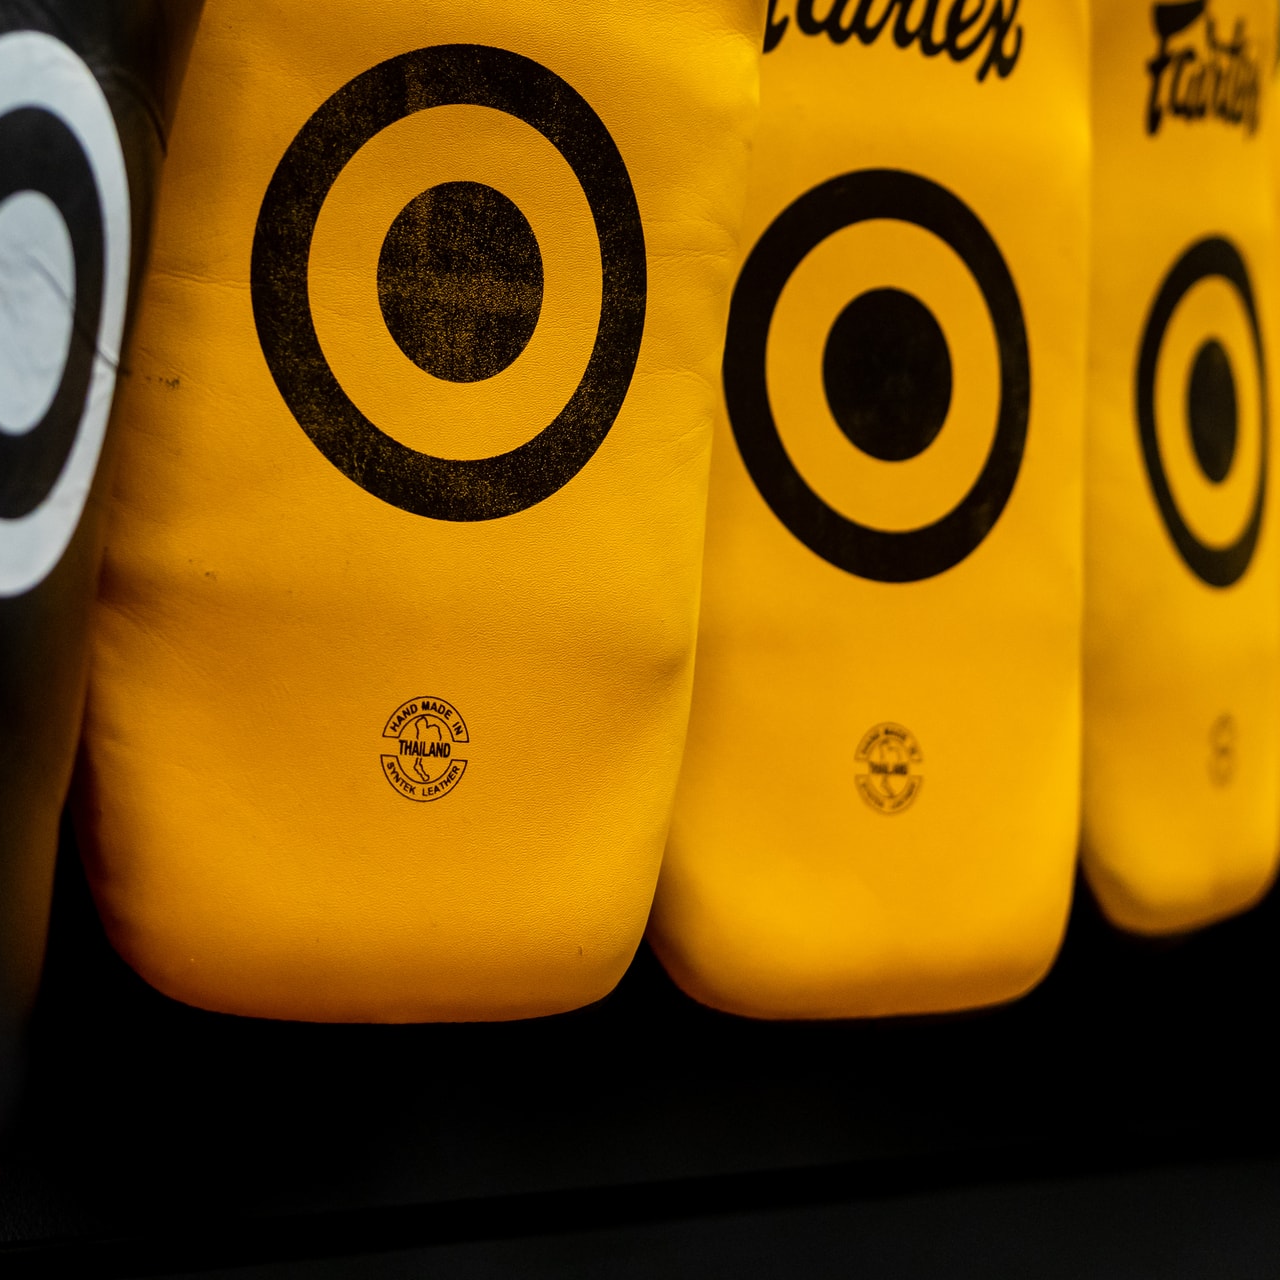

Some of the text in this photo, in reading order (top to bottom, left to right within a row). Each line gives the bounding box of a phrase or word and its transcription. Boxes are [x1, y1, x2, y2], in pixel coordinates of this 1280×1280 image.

[390, 701, 464, 736] HAND MADE IN
[399, 740, 451, 758] THAILAND
[387, 761, 460, 796] SYNTEK LEATHER
